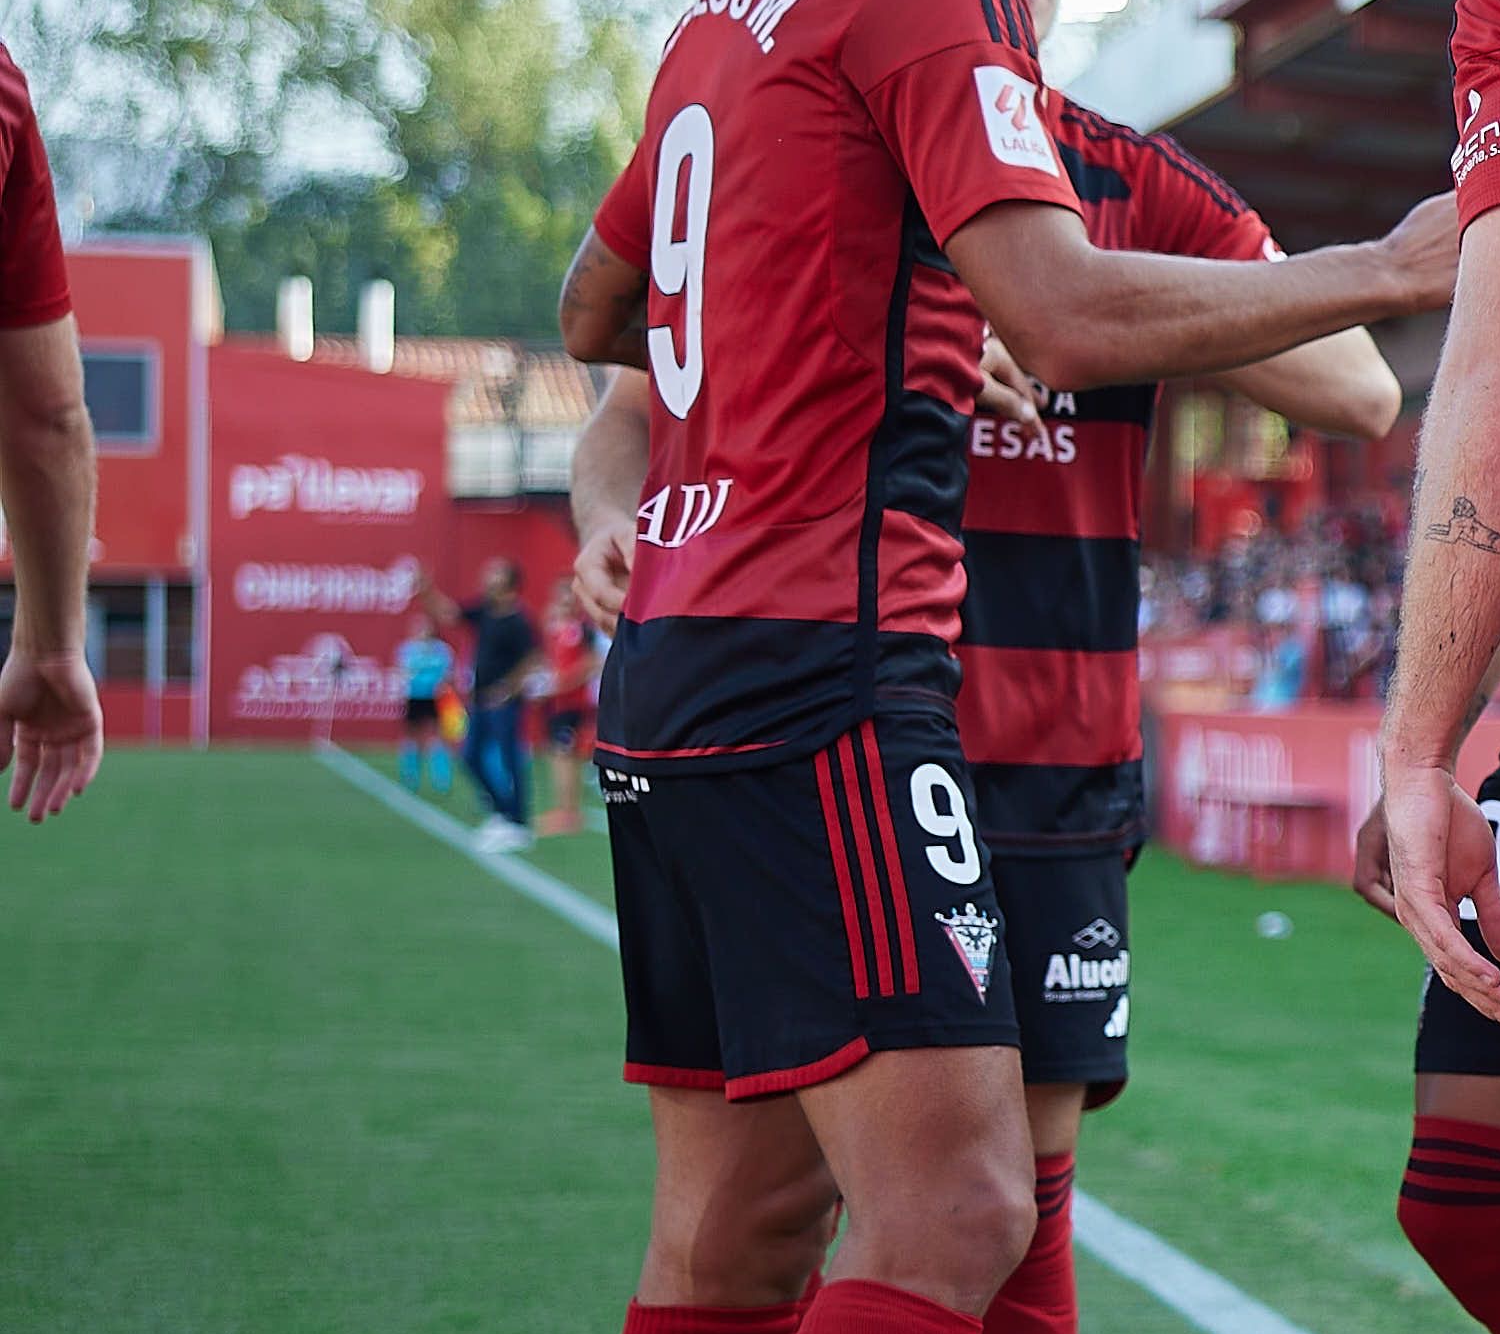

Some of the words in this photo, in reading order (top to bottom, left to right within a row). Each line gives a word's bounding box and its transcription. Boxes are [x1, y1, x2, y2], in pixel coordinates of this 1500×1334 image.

[648, 103, 714, 420] 9
[636, 478, 734, 548] ADI
[909, 763, 984, 885] 9
